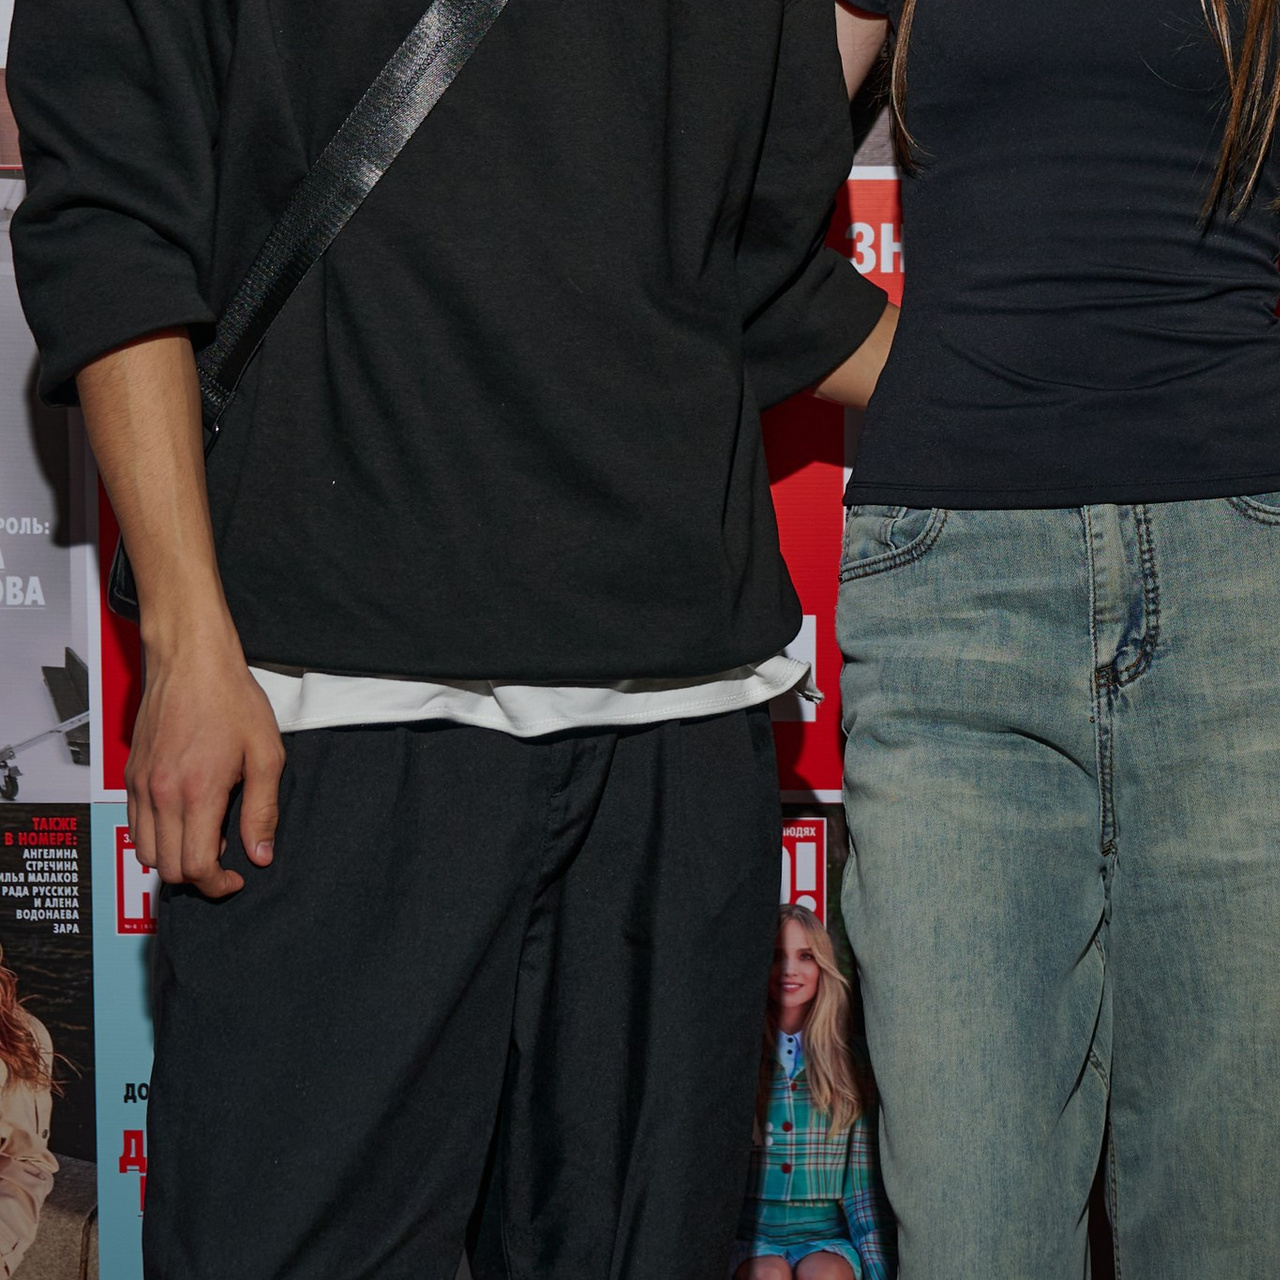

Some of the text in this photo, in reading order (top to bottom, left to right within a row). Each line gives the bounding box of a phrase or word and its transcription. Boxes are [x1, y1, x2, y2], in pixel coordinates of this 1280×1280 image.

[32, 818, 77, 830] ТАКЖЕ
[5, 833, 78, 845] В НОМЕРЕ:
[23, 849, 78, 859] АНГЕЛИНА
[25, 861, 78, 871] СТРЕЧИНА
[28, 873, 78, 883] МАЛАКОВ
[2, 886, 79, 897] РАДА РУССКИХ
[45, 898, 79, 908] АЛЕНА
[16, 910, 79, 921] ВОДОНАЕВА
[53, 924, 80, 934] ЗАРА
